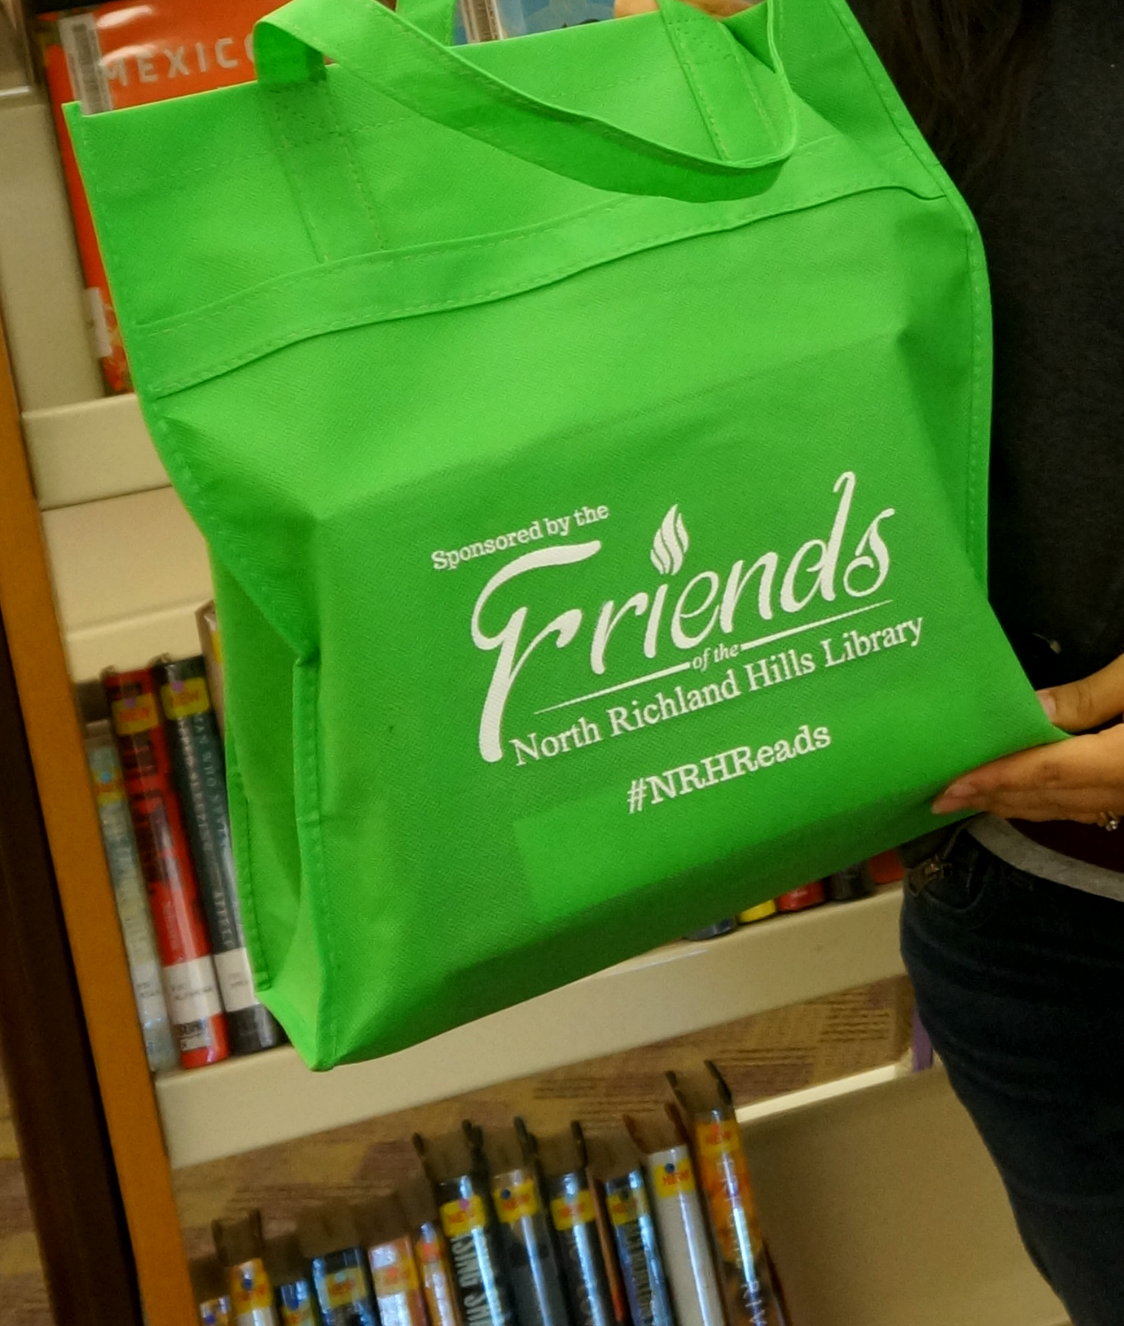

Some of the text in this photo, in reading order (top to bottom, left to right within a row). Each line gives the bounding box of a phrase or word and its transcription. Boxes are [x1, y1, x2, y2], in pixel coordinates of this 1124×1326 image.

[430, 504, 610, 571] Sponsored by the
[471, 470, 896, 764] Friends
[692, 643, 741, 674] of the
[509, 616, 925, 767] North Richland Hills Library
[626, 723, 832, 815] #NRHReads
